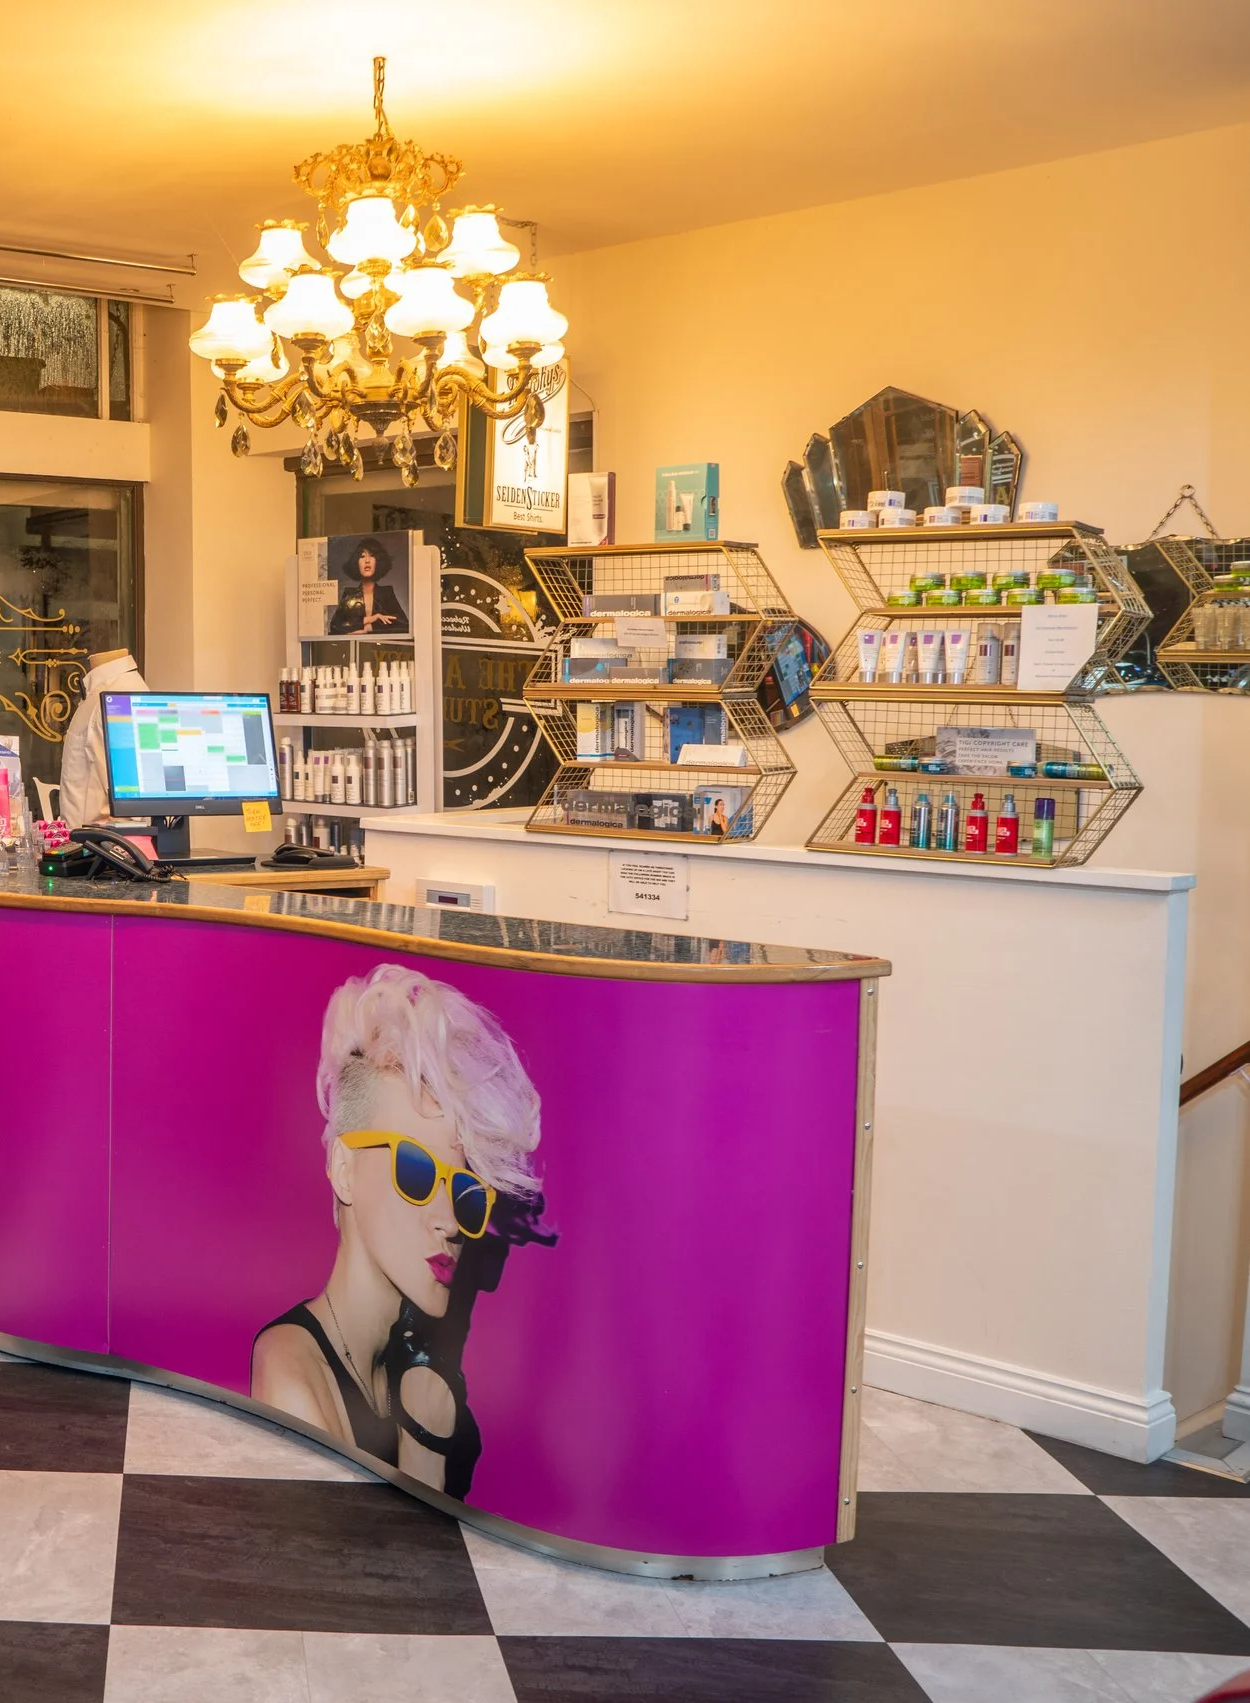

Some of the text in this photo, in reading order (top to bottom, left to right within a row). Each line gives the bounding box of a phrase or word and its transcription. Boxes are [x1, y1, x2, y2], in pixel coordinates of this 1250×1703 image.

[496, 485, 560, 510] SEIDENSTICKER
[513, 511, 525, 521] Best
[589, 609, 651, 617] dermalogica
[570, 818, 623, 828] dermalogica
[635, 893, 661, 901] 541334
